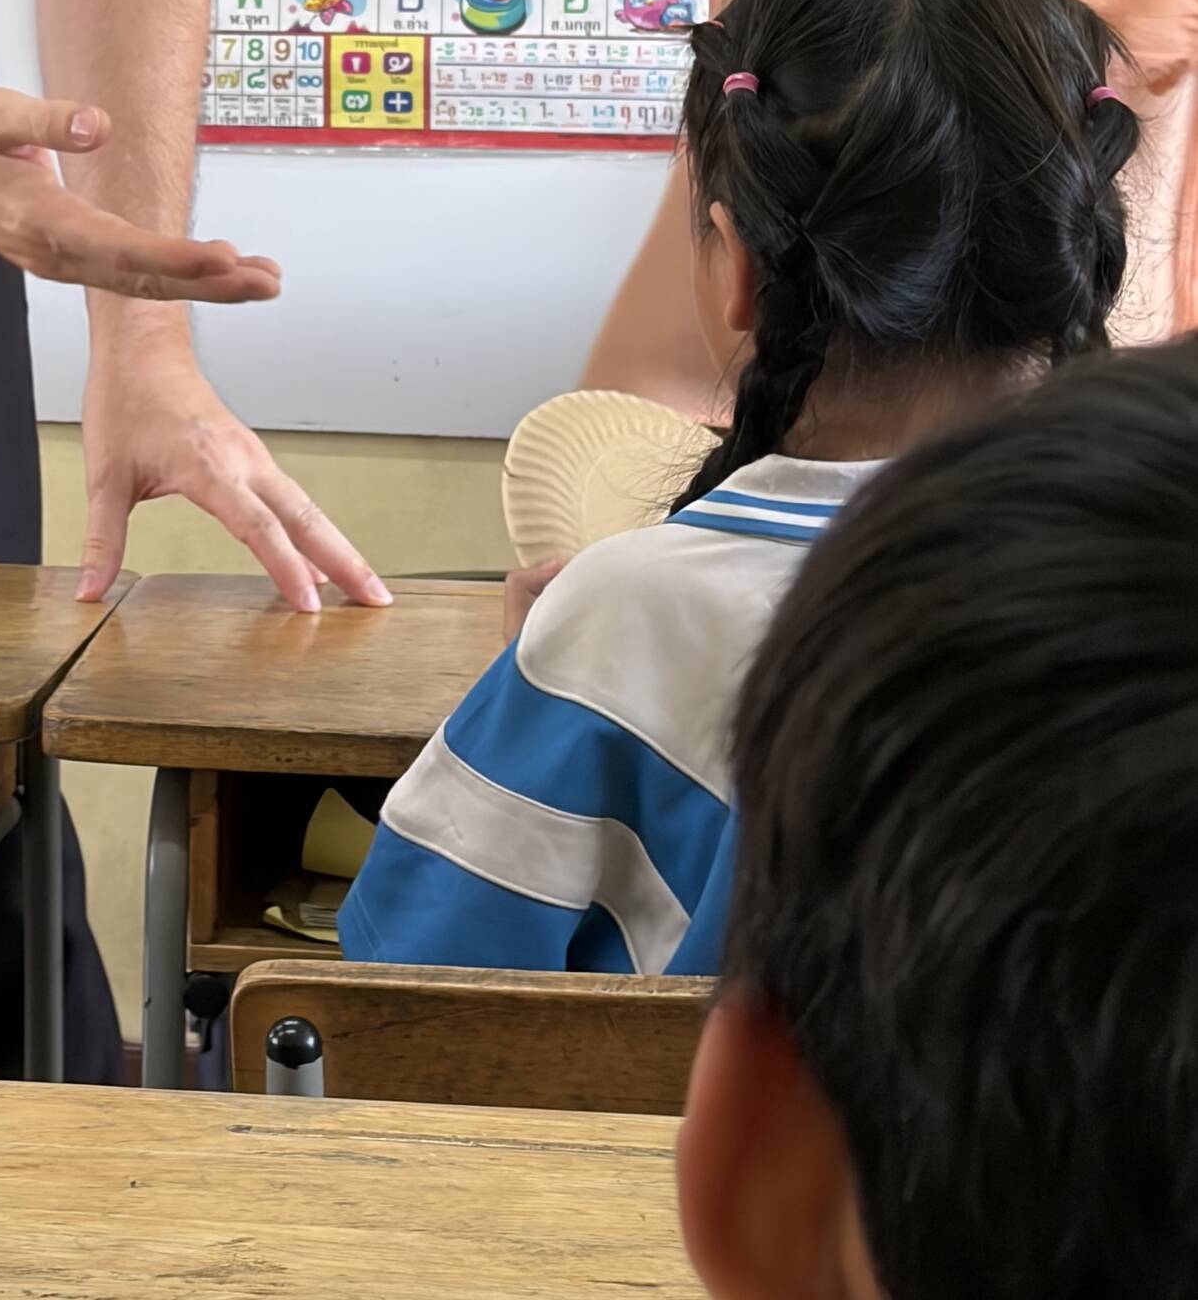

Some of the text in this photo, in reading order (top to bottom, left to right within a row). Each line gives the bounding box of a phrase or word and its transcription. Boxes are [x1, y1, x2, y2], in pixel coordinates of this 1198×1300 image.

[222, 38, 322, 62] 7 8 9 10
[216, 70, 240, 89] ๗
[246, 69, 266, 89] ๘
[272, 70, 294, 90] ๙
